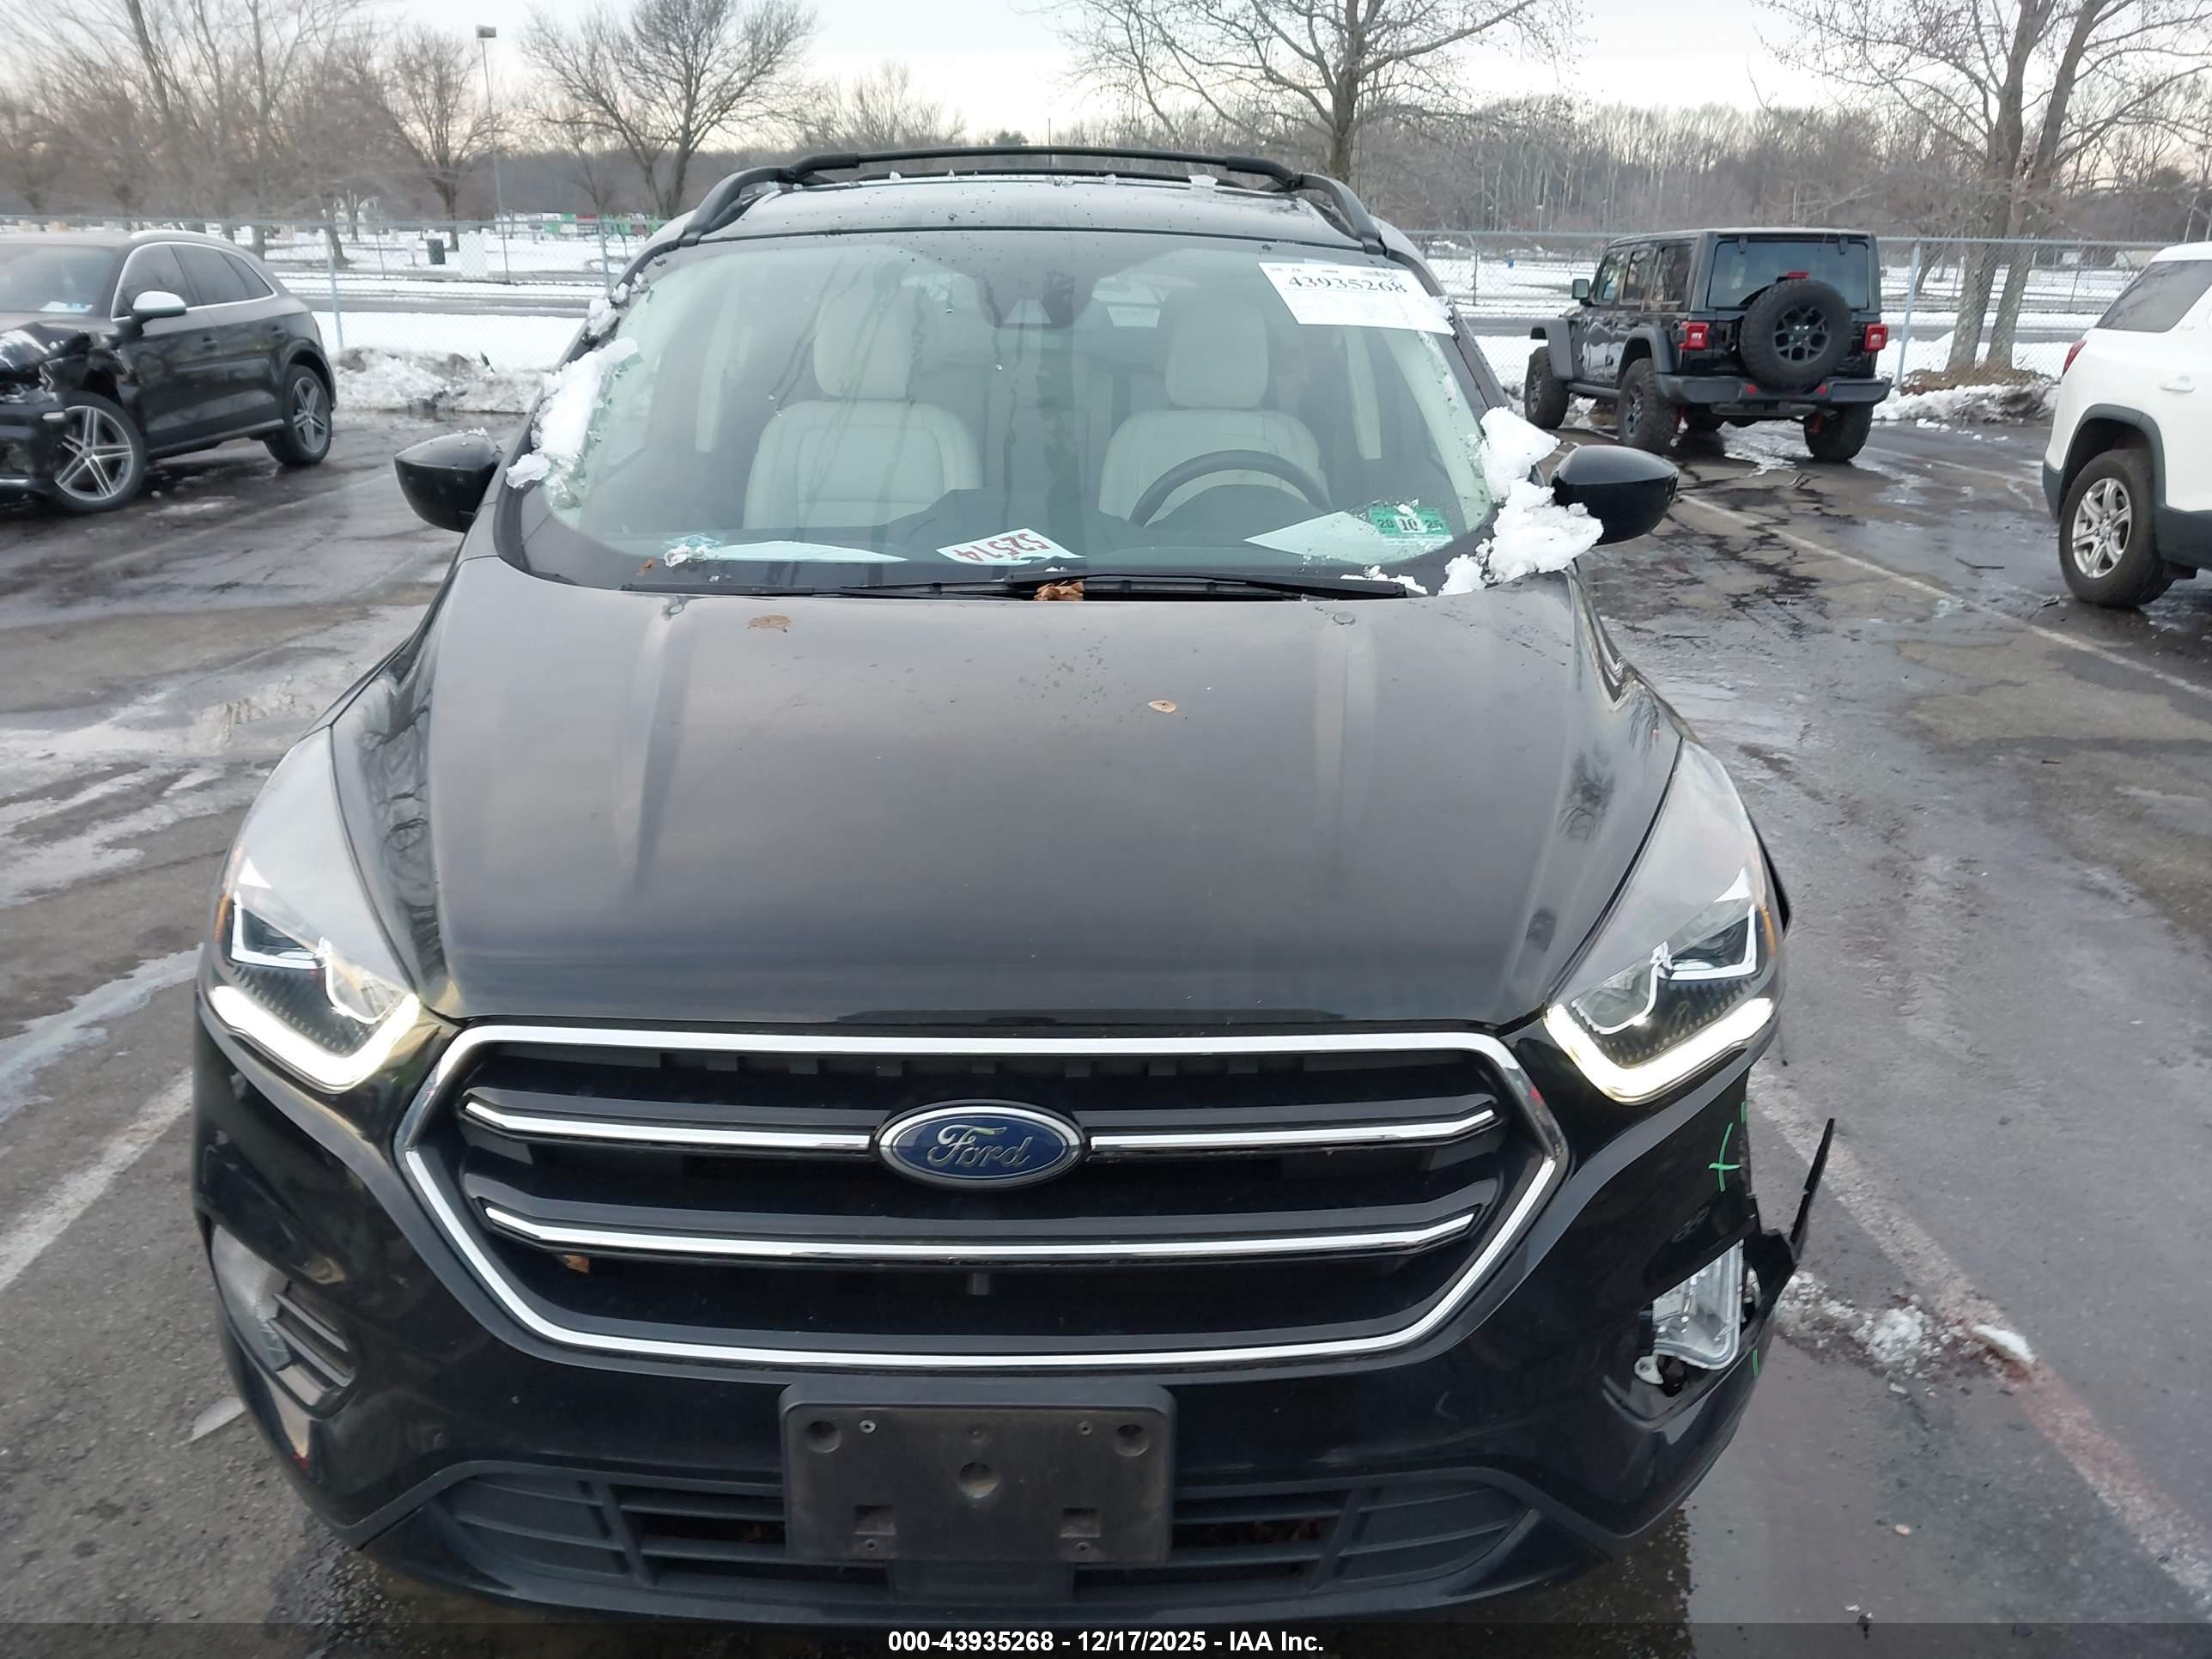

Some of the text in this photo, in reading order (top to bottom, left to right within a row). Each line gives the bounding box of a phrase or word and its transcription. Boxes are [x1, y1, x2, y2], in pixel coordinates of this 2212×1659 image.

[1288, 276, 1407, 294] 43935268
[1377, 519, 1395, 529] 20
[1399, 517, 1419, 531] 10
[952, 532, 1052, 562] 52514
[927, 1124, 1034, 1168] Ford
